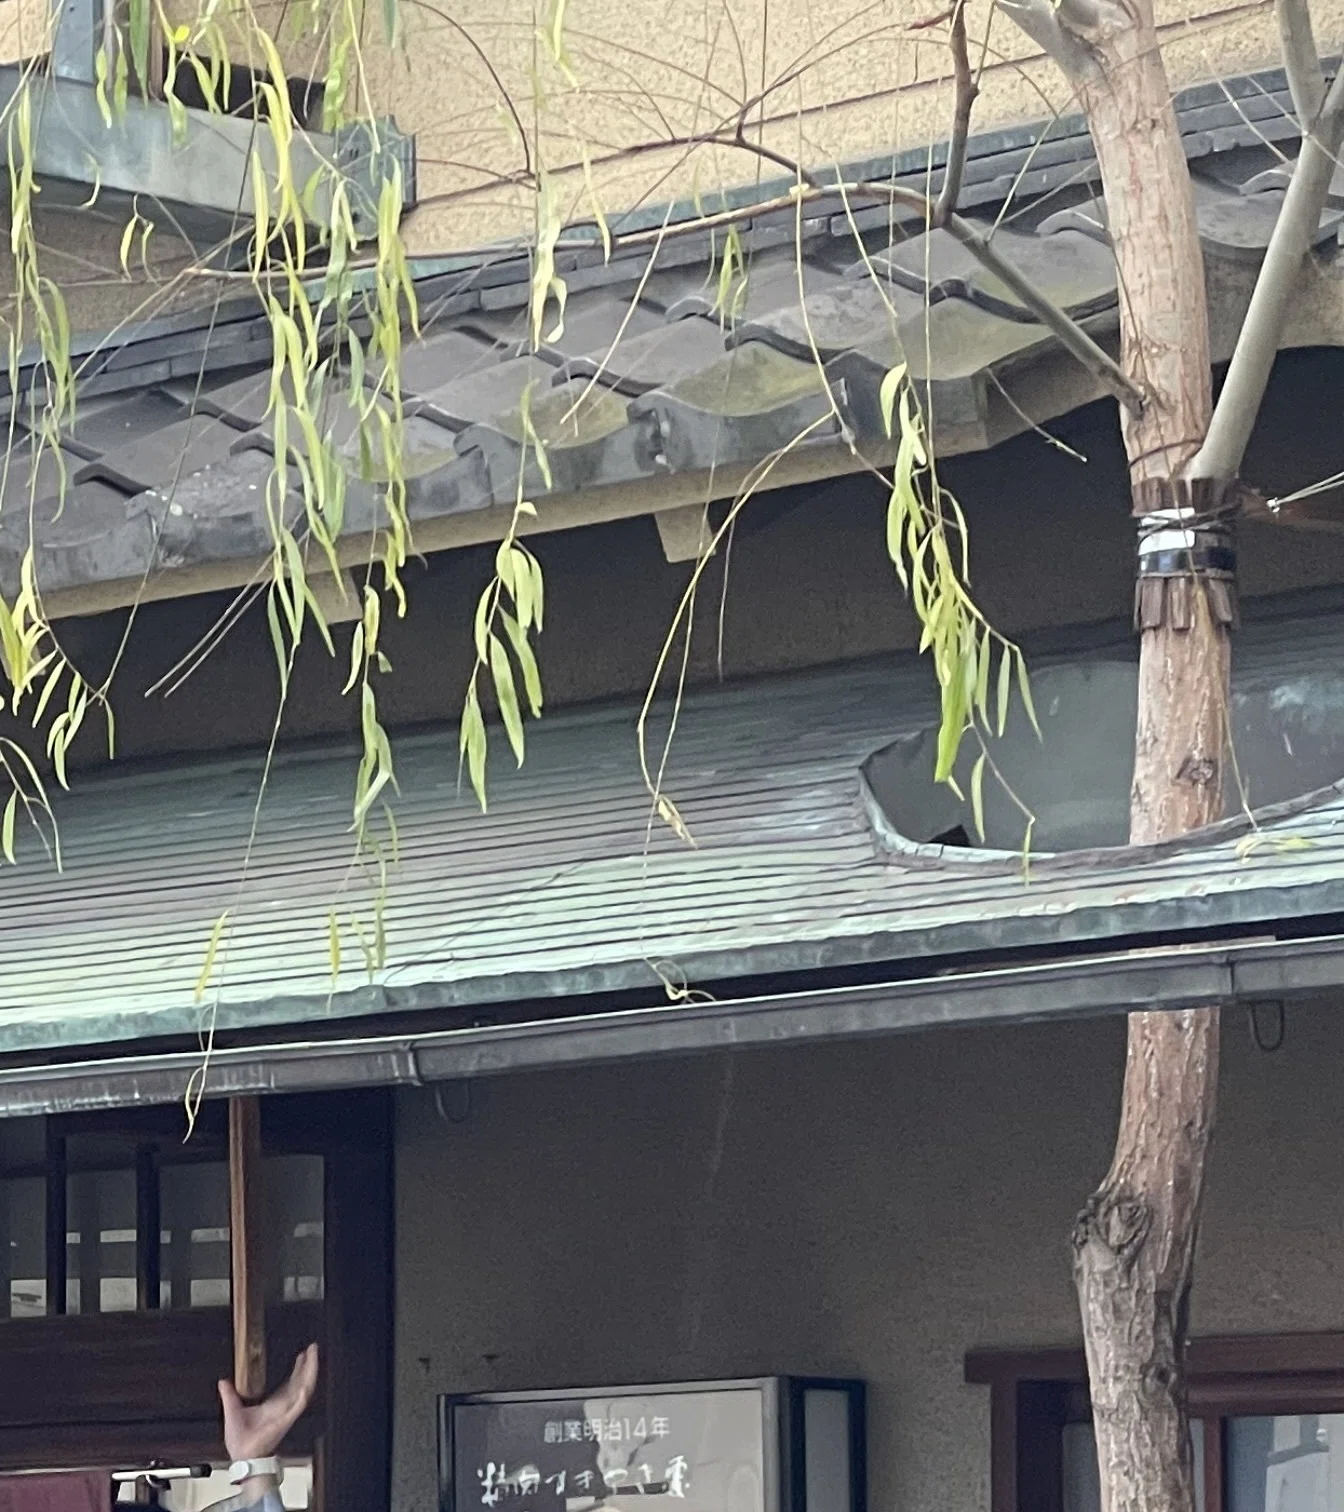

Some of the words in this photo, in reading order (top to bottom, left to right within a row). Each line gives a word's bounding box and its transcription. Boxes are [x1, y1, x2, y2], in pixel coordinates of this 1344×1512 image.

[543, 1415, 673, 1444] 創業明治14年
